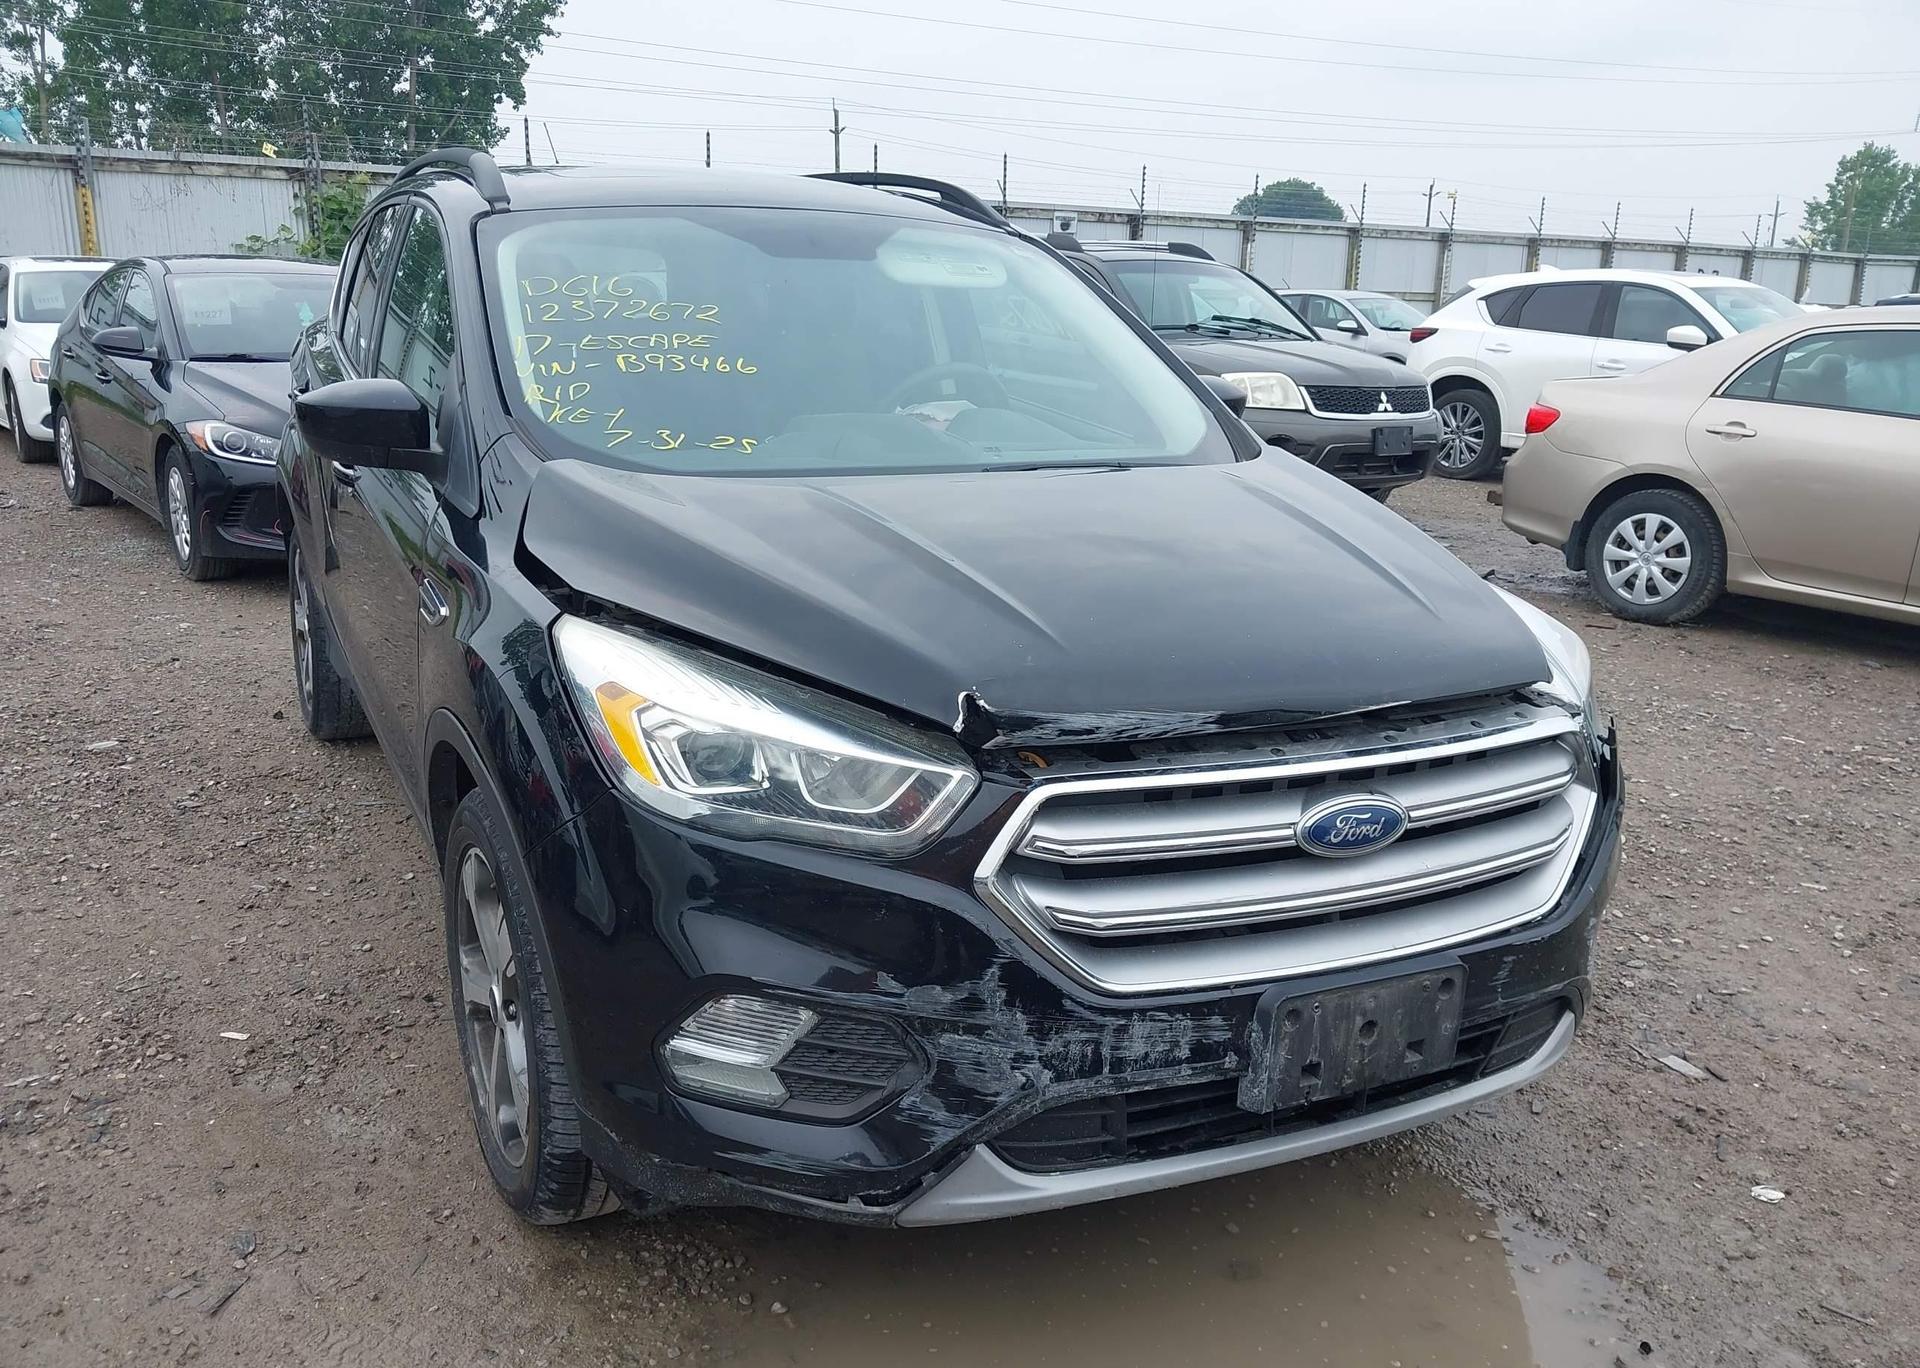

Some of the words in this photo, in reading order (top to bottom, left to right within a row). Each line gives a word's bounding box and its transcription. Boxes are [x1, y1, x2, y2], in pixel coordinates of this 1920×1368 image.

[524, 299, 722, 324] 12372672
[547, 401, 625, 430] KEY
[1330, 812, 1386, 844] Ford
